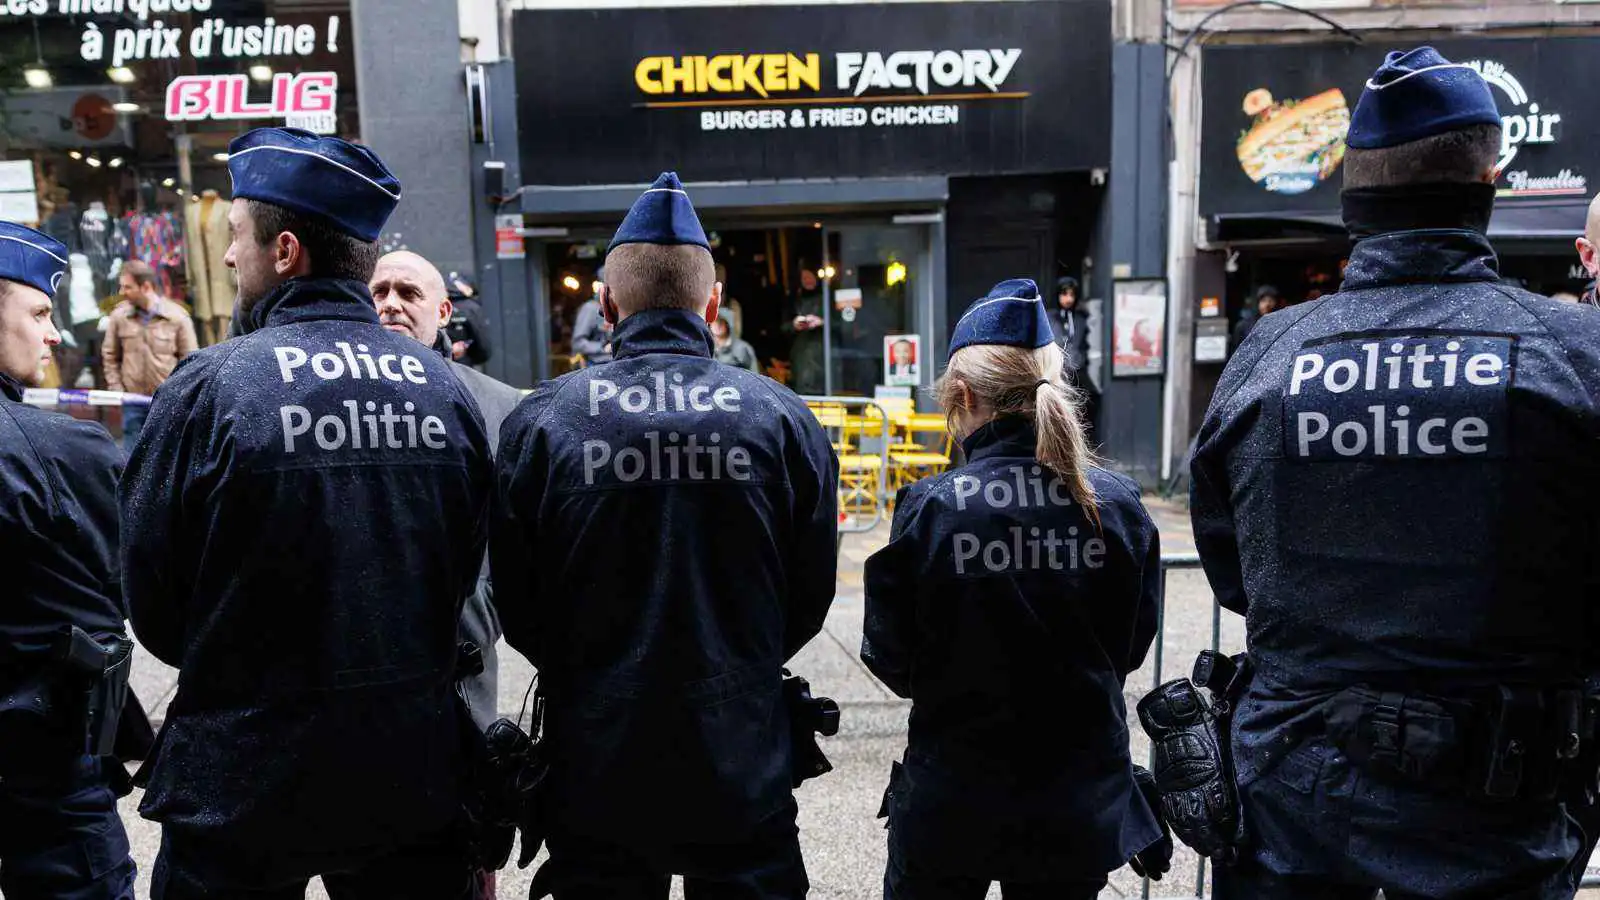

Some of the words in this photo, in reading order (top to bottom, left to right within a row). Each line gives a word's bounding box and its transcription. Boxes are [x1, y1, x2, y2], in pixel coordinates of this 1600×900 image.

[80, 22, 104, 61] à
[112, 19, 182, 68] prix
[190, 17, 315, 58] d'usine
[327, 15, 339, 52] !
[168, 74, 335, 118] BILIG
[635, 52, 820, 97] CHICKEN
[836, 48, 1021, 96] FACTORY
[701, 110, 786, 130] BURGER
[790, 109, 805, 129] &
[809, 108, 867, 127] FRIED
[871, 105, 959, 126] CHICKEN
[1500, 102, 1561, 155] pir
[273, 342, 427, 383] Police
[1289, 341, 1503, 395] Politie
[589, 371, 741, 416] Police
[280, 400, 446, 453] Politie
[1298, 405, 1489, 456] Police
[583, 430, 752, 485] Politie
[953, 466, 1071, 511] Polic
[953, 526, 1106, 574] Politie
